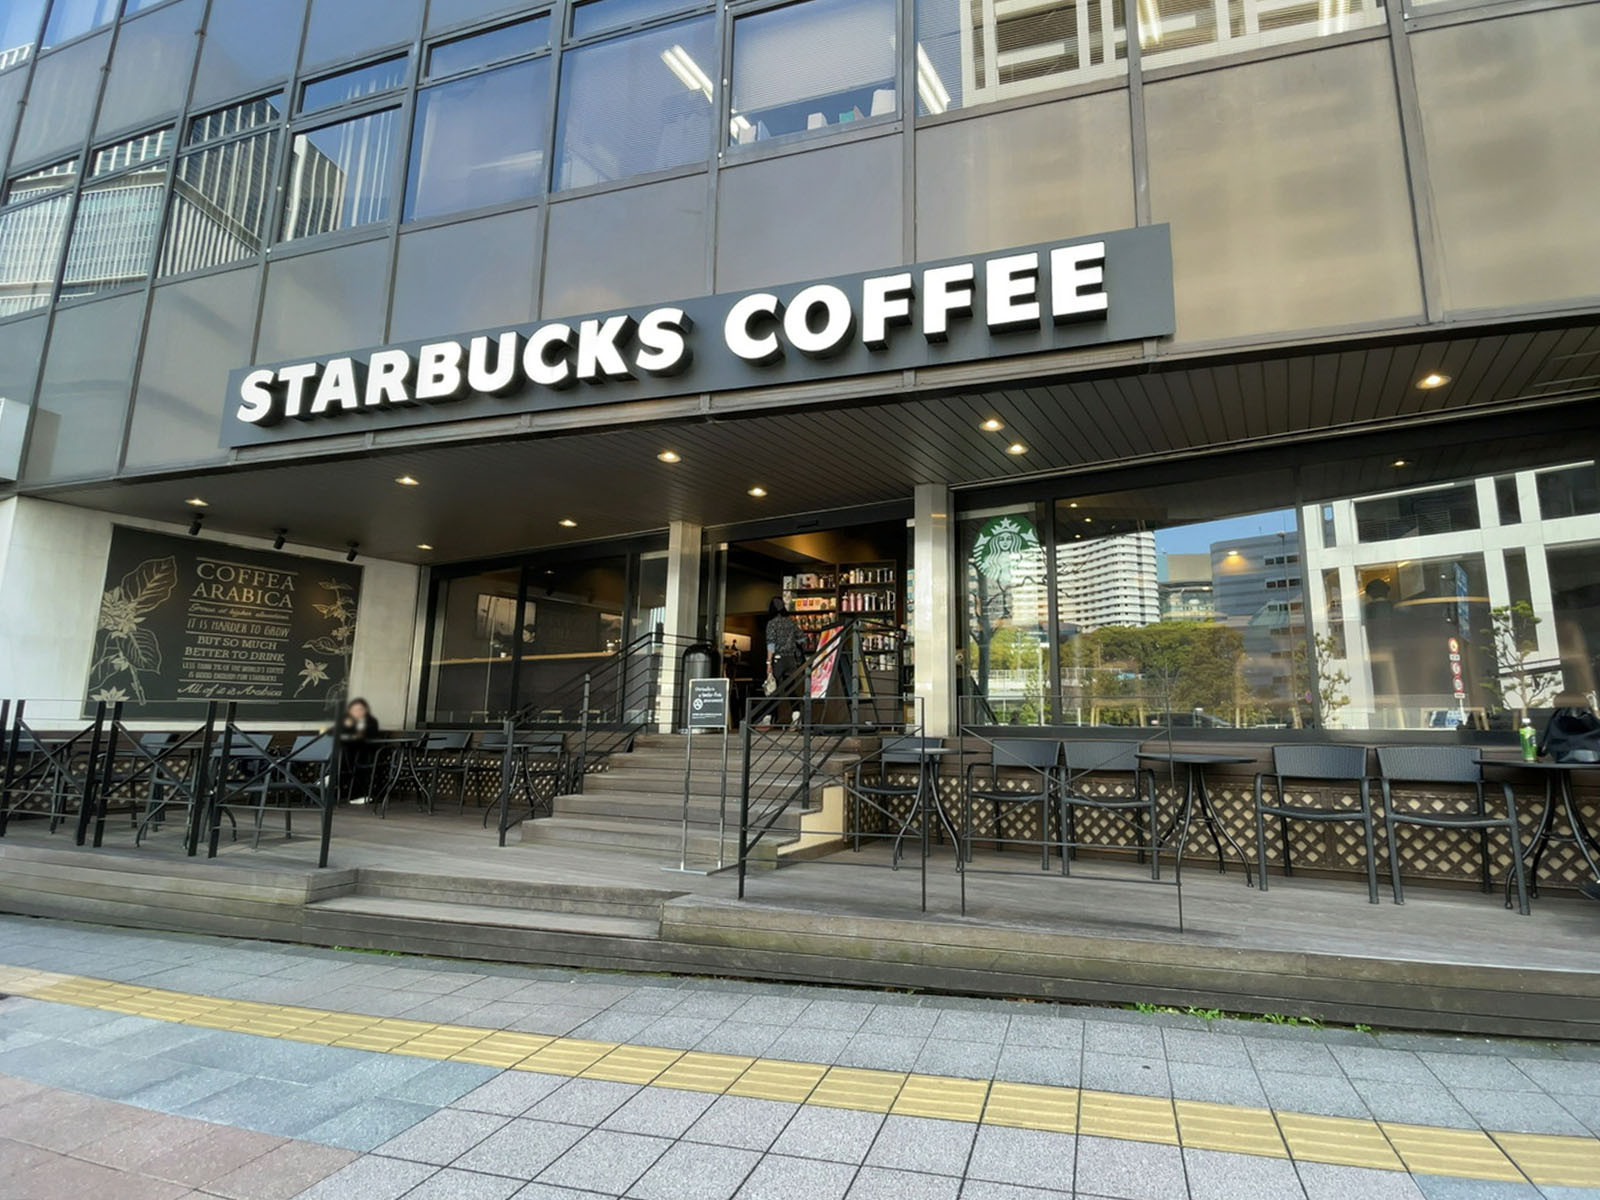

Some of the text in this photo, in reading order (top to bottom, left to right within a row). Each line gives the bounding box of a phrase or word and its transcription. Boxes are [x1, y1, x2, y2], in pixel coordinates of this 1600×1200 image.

[236, 241, 1109, 424] STARBUCKS COFFEE
[196, 562, 295, 591] COFFEA
[192, 582, 293, 608] ARABICA
[187, 618, 197, 629] IT
[199, 619, 208, 630] IS
[211, 621, 248, 634] HARDER
[250, 624, 262, 635] TO
[197, 635, 278, 650] BUT SO MUCH
[184, 646, 285, 662] BETTER TO DRINK
[177, 683, 202, 694] All
[236, 685, 283, 697] Arabica
